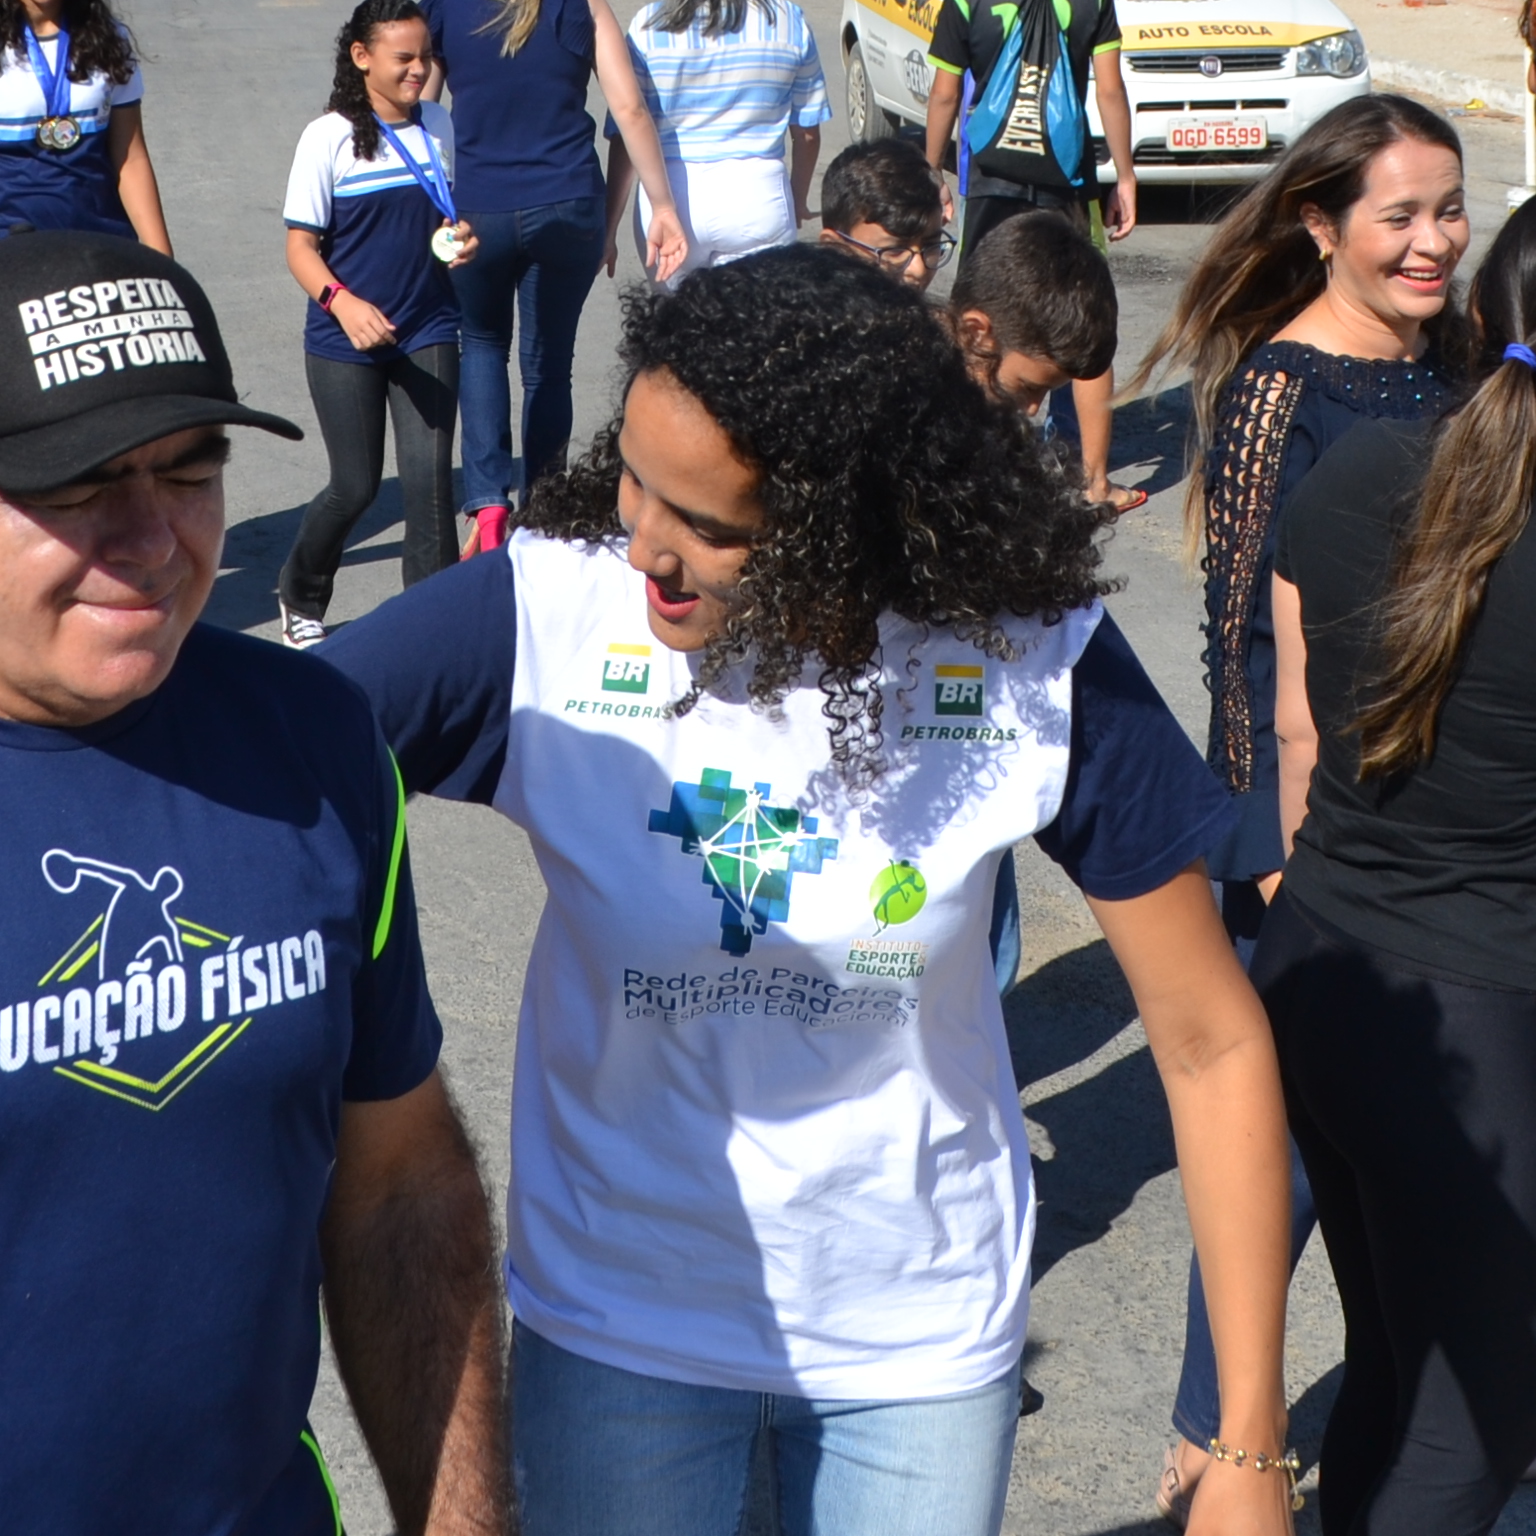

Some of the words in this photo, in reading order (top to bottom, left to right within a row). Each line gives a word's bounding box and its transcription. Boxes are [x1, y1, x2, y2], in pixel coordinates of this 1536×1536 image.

[1138, 26, 1190, 41] AUTO
[1198, 24, 1273, 37] ESCOLA
[18, 278, 186, 334] RESPEITA
[45, 334, 61, 347] A
[84, 315, 183, 337] MINHA
[34, 328, 206, 390] HISTÓRIA
[605, 660, 646, 682] BR
[939, 683, 978, 703] BR
[564, 699, 673, 721] PETROBRAS
[900, 726, 1017, 741] PETROBRAS
[201, 929, 326, 1021] FÍSICA
[846, 962, 925, 981] EDUCAÇÃO
[624, 968, 706, 990] Rede
[718, 966, 758, 983] de
[771, 968, 919, 1010] Parceiros
[624, 980, 909, 1020] Multiplicadores
[625, 1005, 656, 1020] de
[664, 997, 756, 1025] Esporte
